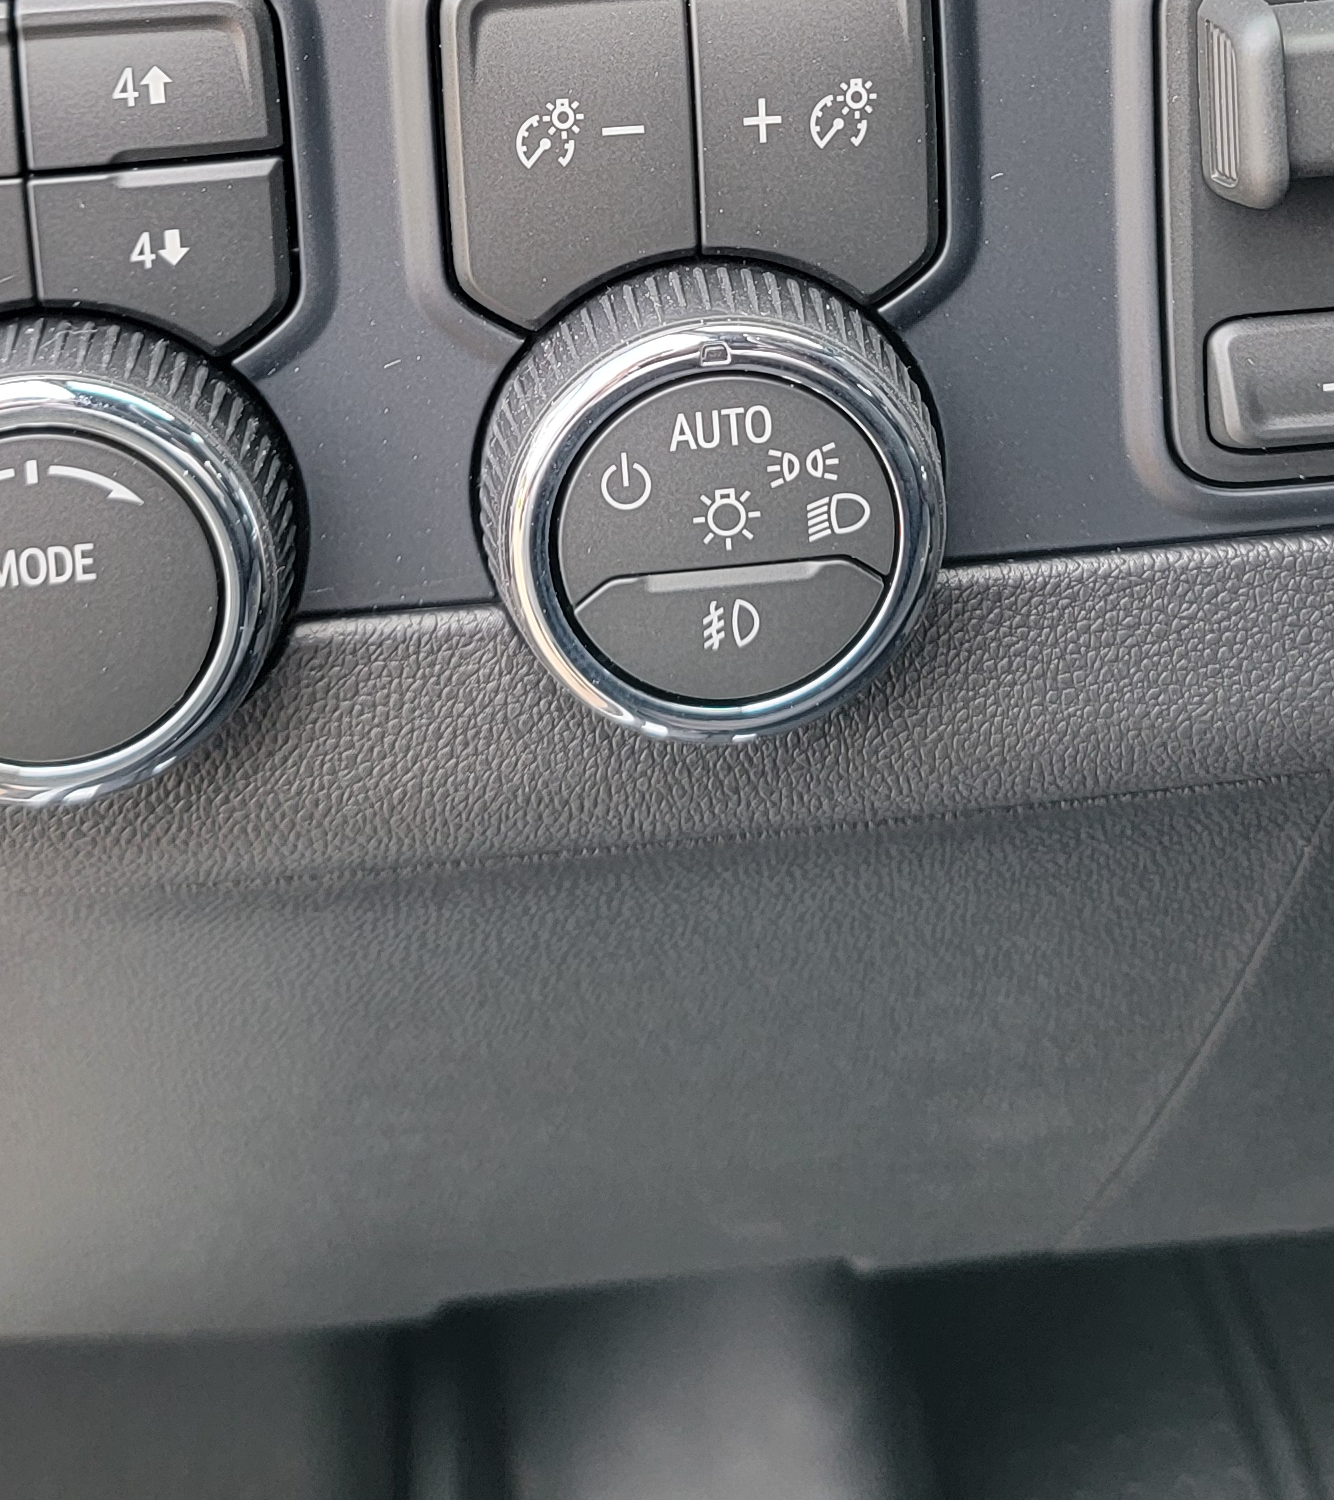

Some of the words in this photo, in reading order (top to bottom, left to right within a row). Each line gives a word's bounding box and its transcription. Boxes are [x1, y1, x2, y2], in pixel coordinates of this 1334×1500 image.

[112, 66, 141, 108] 4
[129, 231, 157, 270] 4
[669, 406, 773, 453] AUTO
